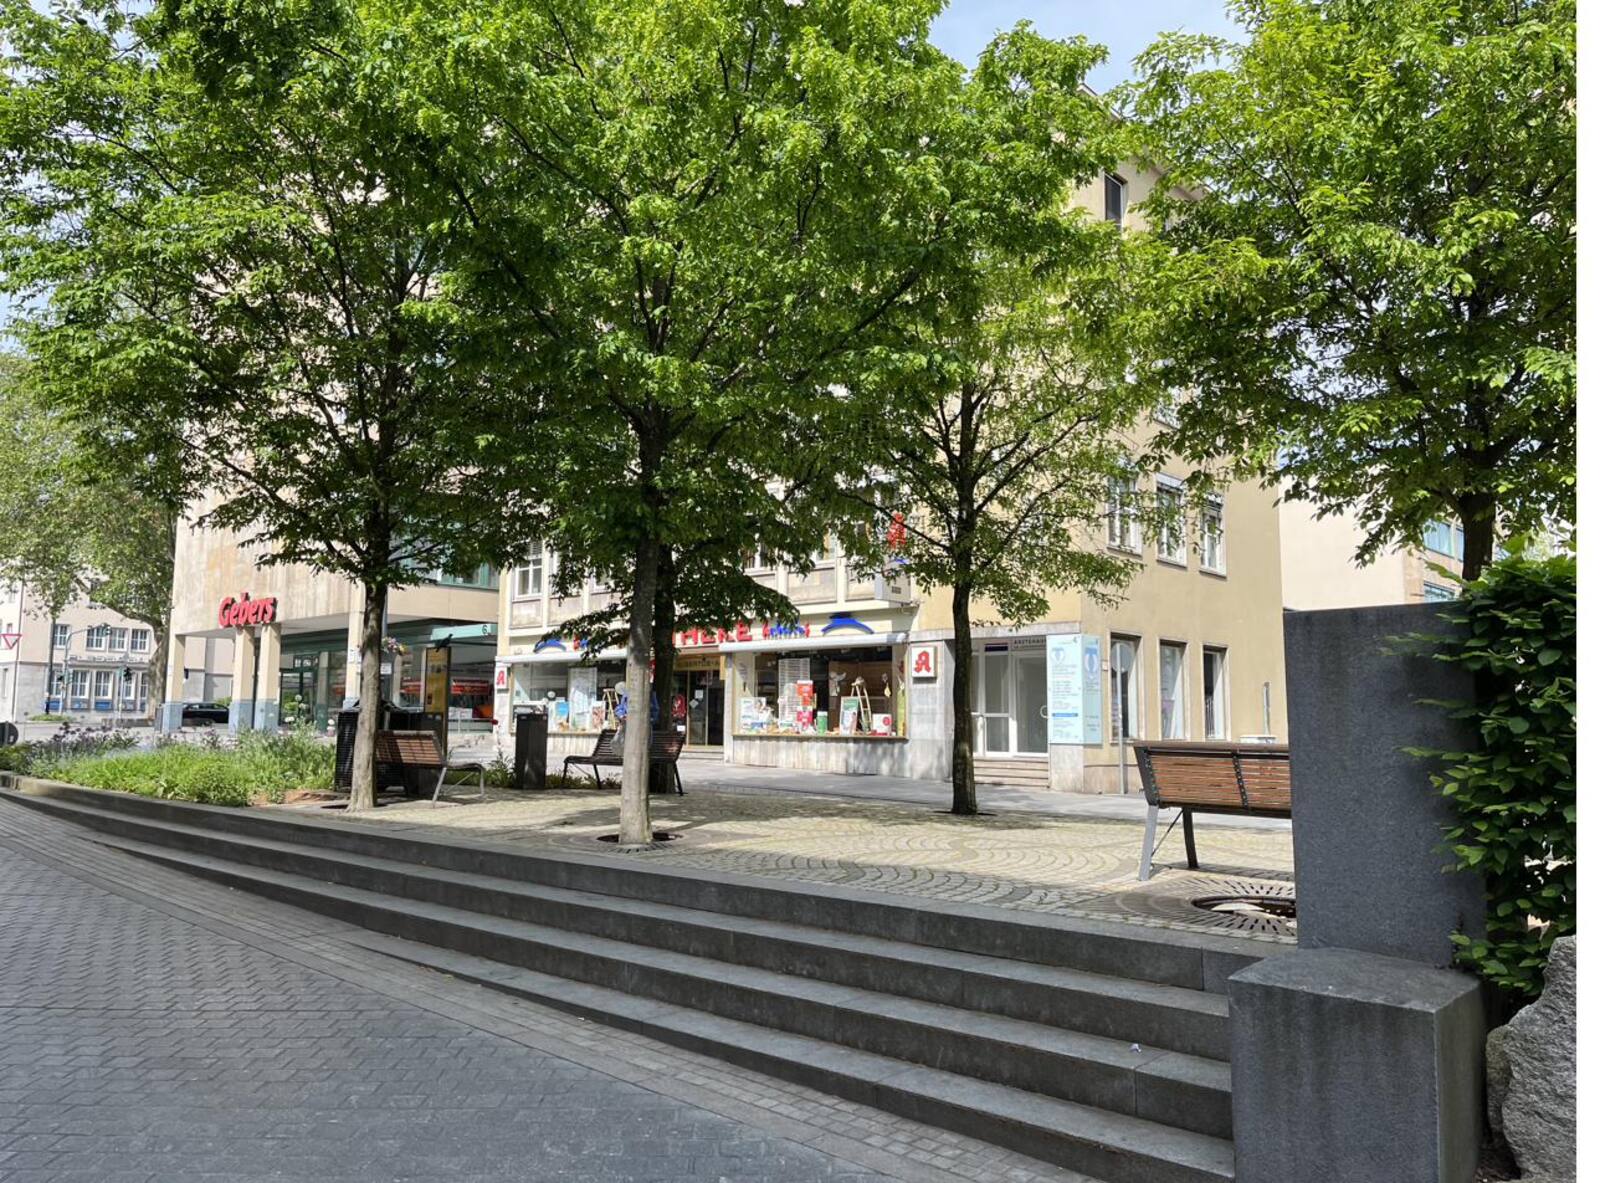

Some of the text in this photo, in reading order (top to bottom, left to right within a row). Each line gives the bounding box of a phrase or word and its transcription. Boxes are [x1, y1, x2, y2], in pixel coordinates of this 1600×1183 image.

[217, 592, 276, 628] Gebers
[482, 624, 488, 635] 6
[914, 650, 932, 673] A
[496, 670, 505, 685] A
